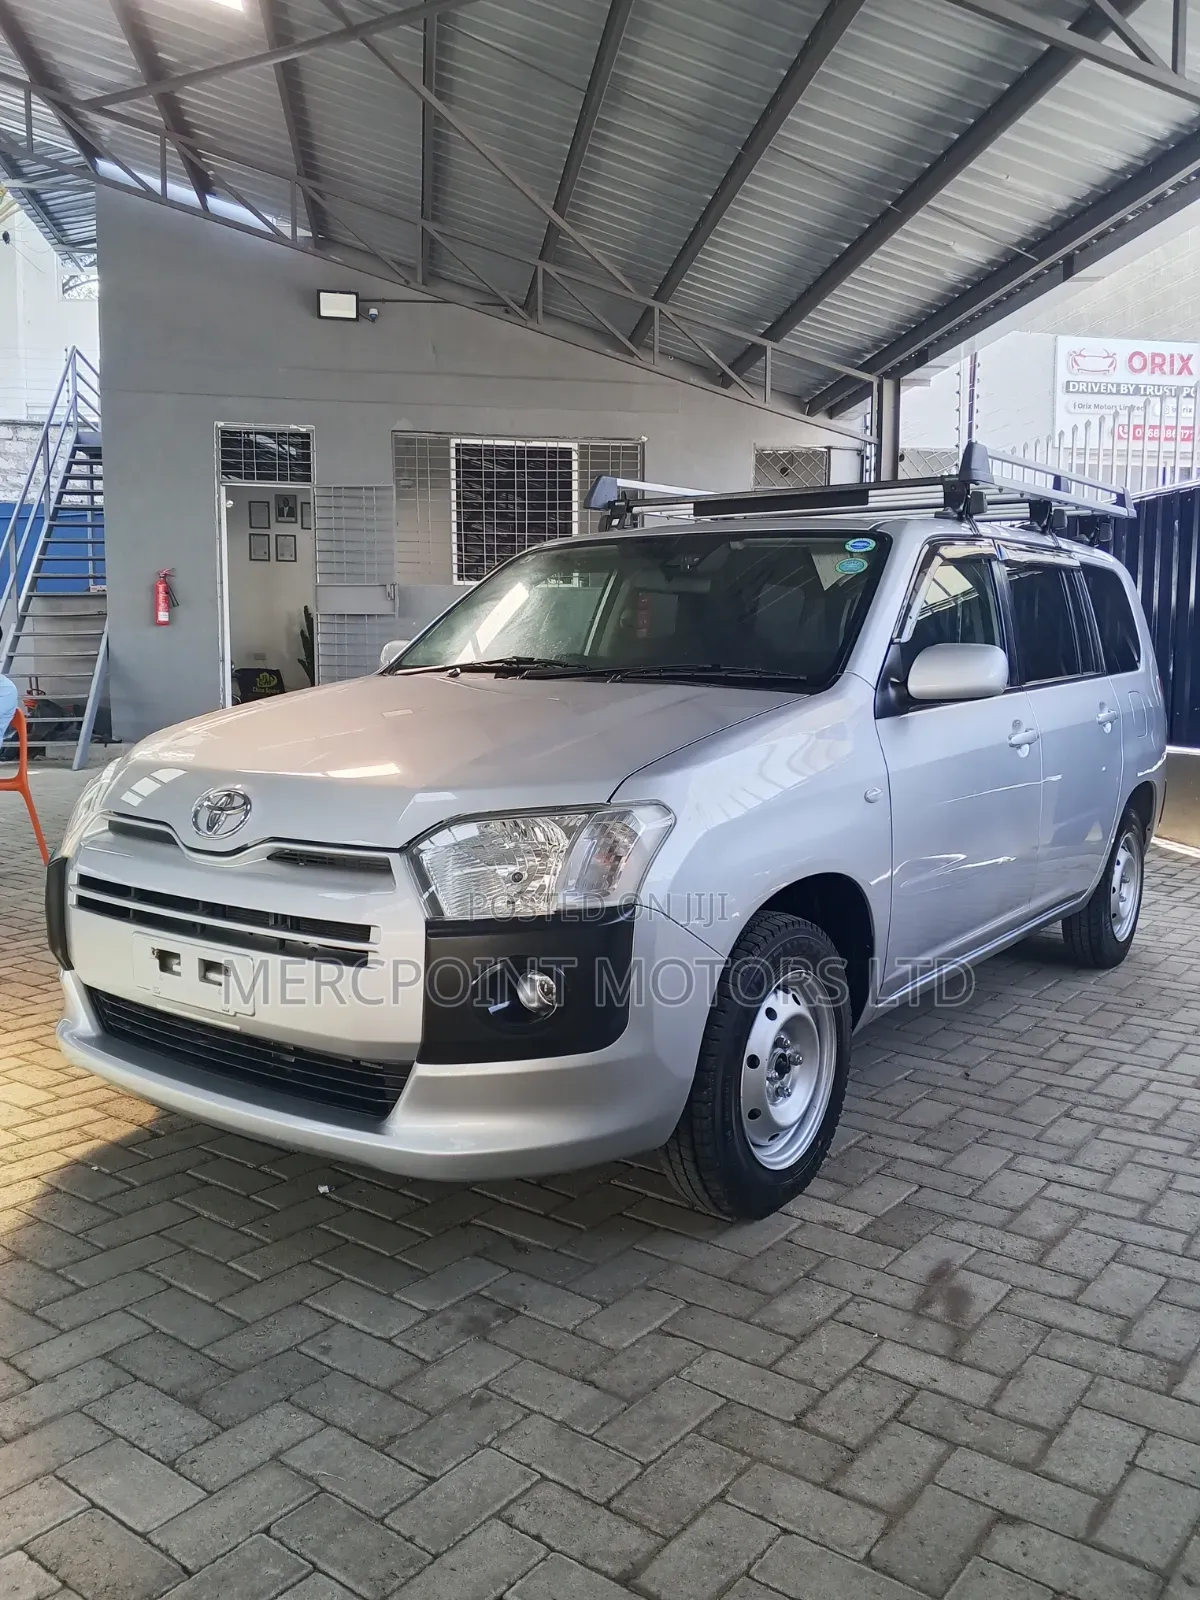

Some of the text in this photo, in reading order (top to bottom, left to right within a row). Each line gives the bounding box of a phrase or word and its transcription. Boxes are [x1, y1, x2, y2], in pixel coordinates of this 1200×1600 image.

[1127, 350, 1194, 376] ORIX
[1069, 381, 1117, 394] DRIVEN
[1120, 383, 1136, 395] BY
[1139, 384, 1178, 397] TRUST
[1077, 402, 1092, 410] Orix
[1093, 403, 1117, 411] Motors
[1119, 404, 1145, 412] Limted
